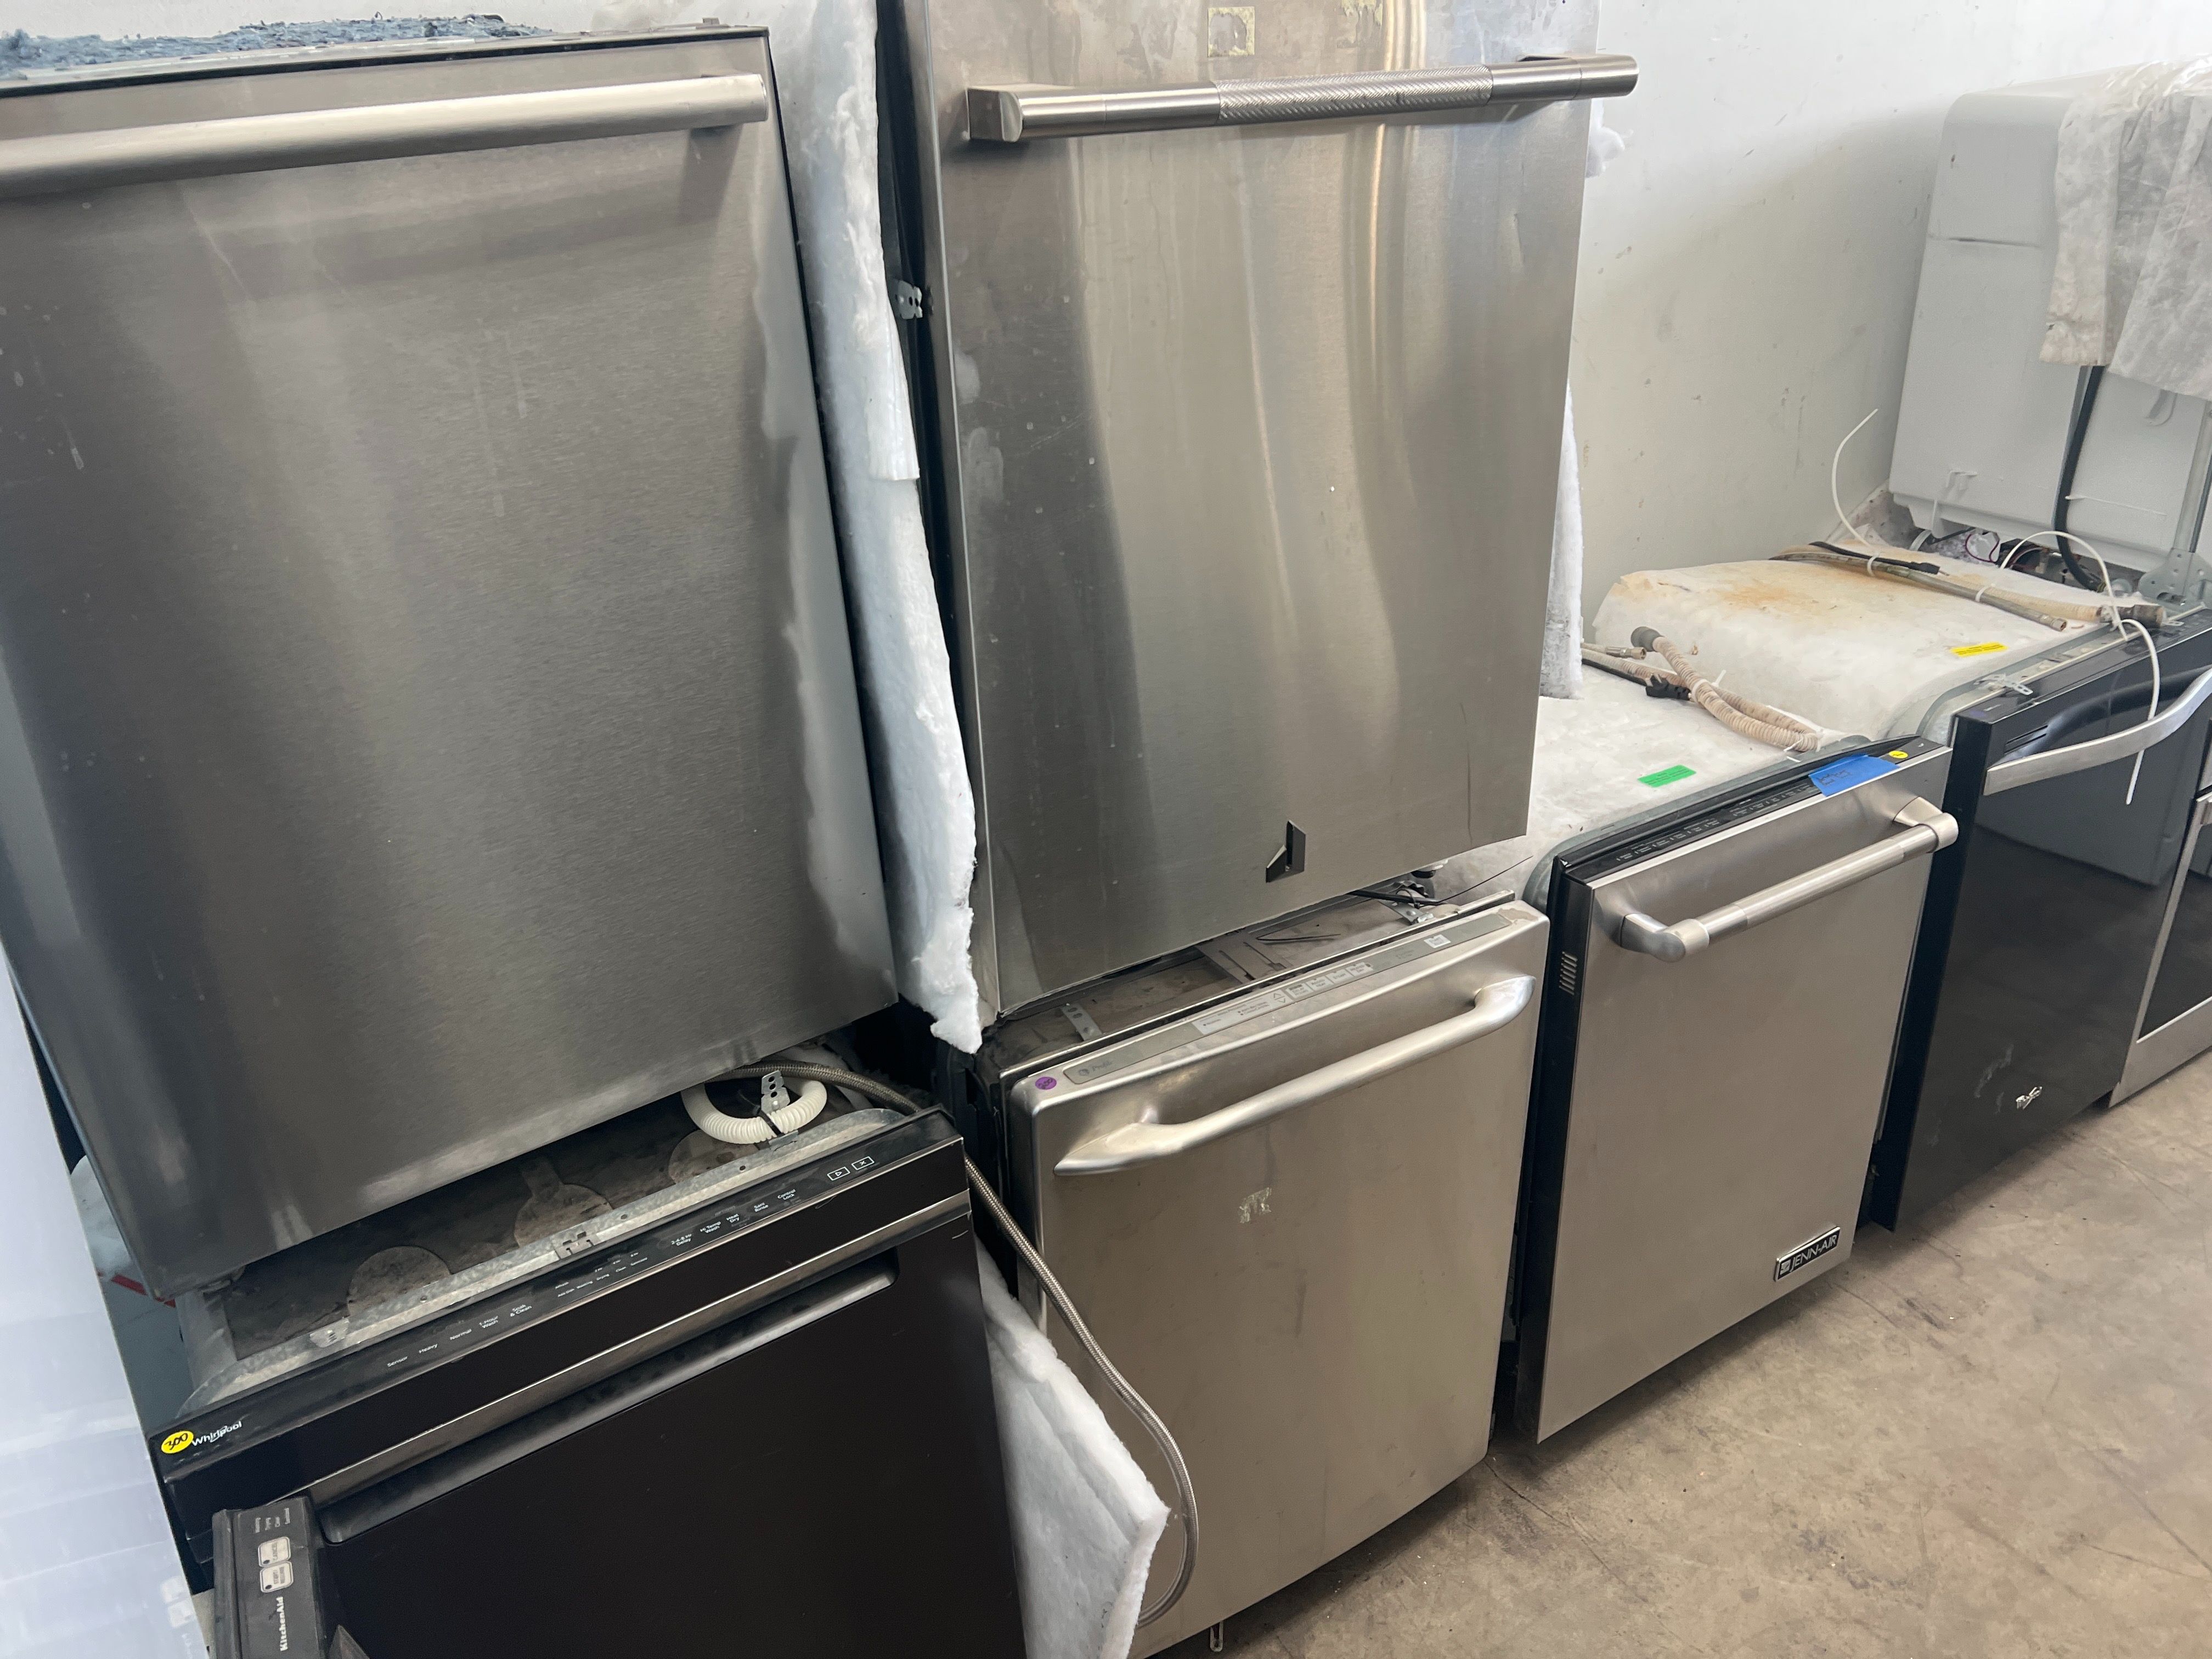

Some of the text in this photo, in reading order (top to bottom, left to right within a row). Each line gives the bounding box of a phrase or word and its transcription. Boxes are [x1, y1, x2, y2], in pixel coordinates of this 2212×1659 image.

[777, 1189, 796, 1199] Control
[676, 1238, 691, 1246] Delay
[1790, 1234, 1837, 1273] JENN-AIR
[512, 1304, 526, 1312] Soak
[516, 1306, 532, 1314] Clean
[482, 1319, 498, 1328] Wash
[449, 1328, 472, 1340] Normal
[419, 1344, 438, 1353] Heavy
[387, 1356, 408, 1367] Sensor
[192, 1421, 242, 1446] Whirlpool
[164, 1432, 188, 1451] 300
[275, 1596, 288, 1652] KitchenAid
